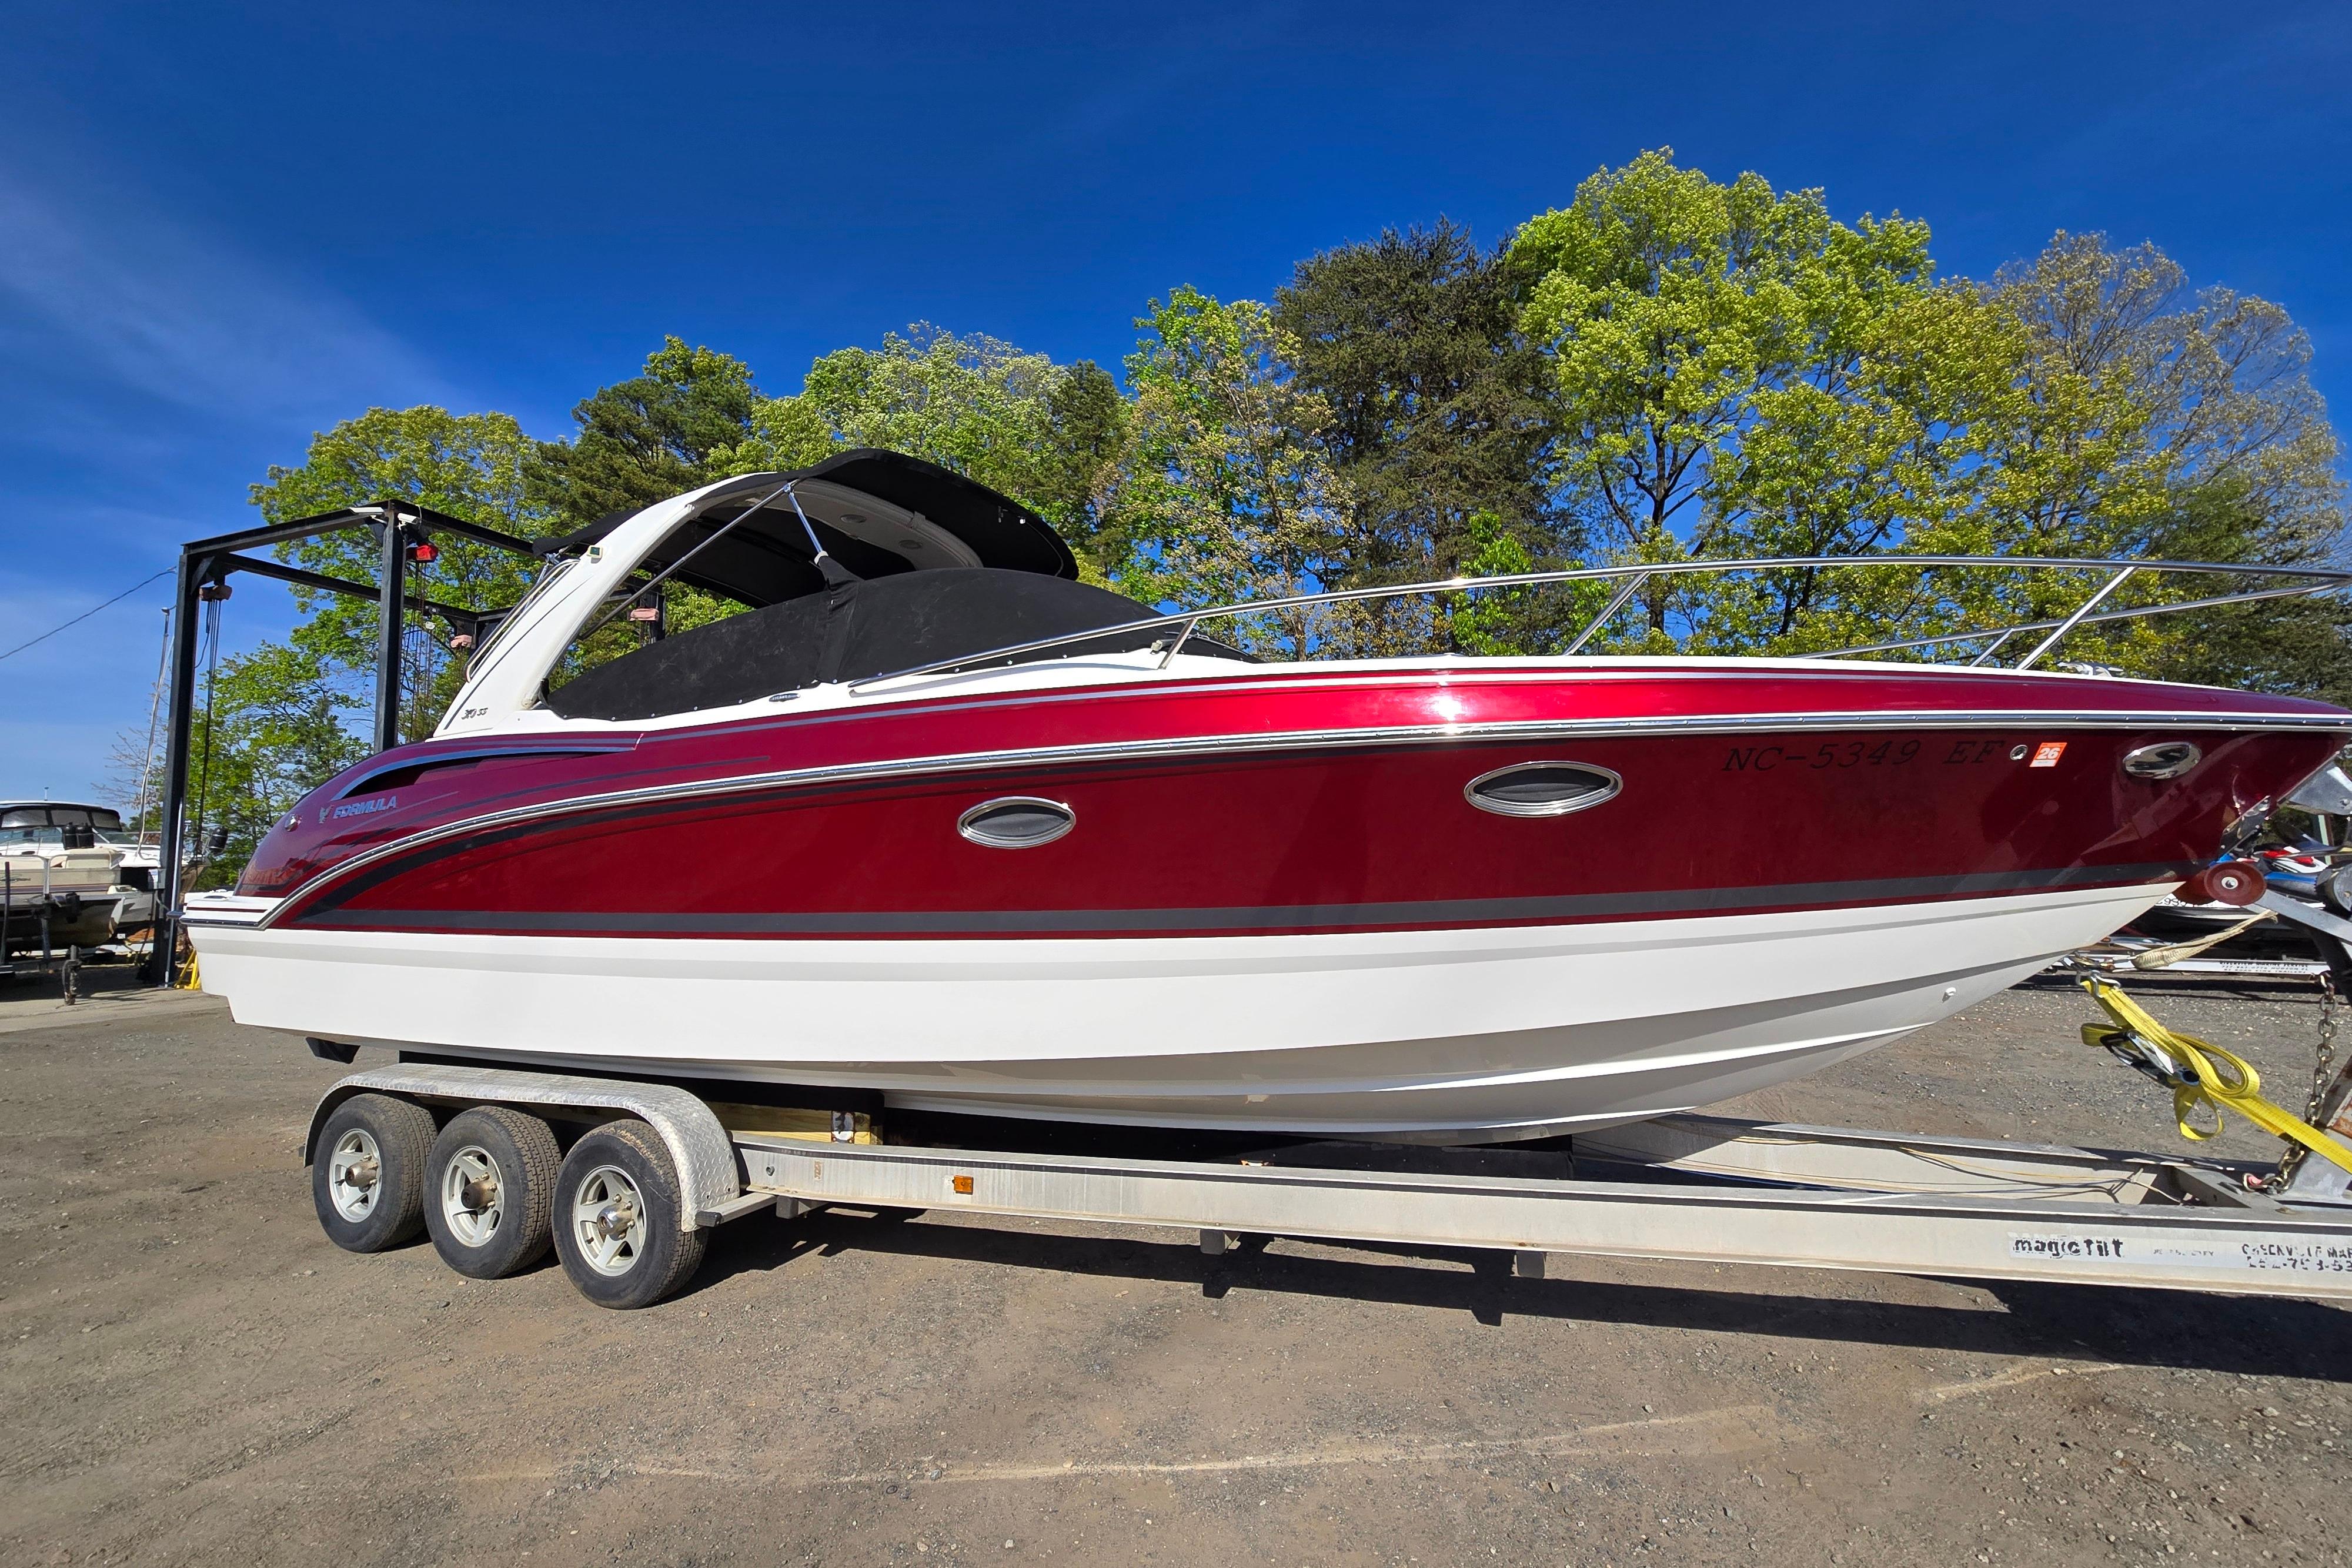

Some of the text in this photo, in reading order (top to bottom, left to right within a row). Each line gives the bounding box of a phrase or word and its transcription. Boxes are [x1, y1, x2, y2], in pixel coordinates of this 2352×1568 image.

[1721, 739, 1922, 771] NC-5349
[2036, 747, 2061, 760] 26
[333, 795, 397, 819] FORMULA
